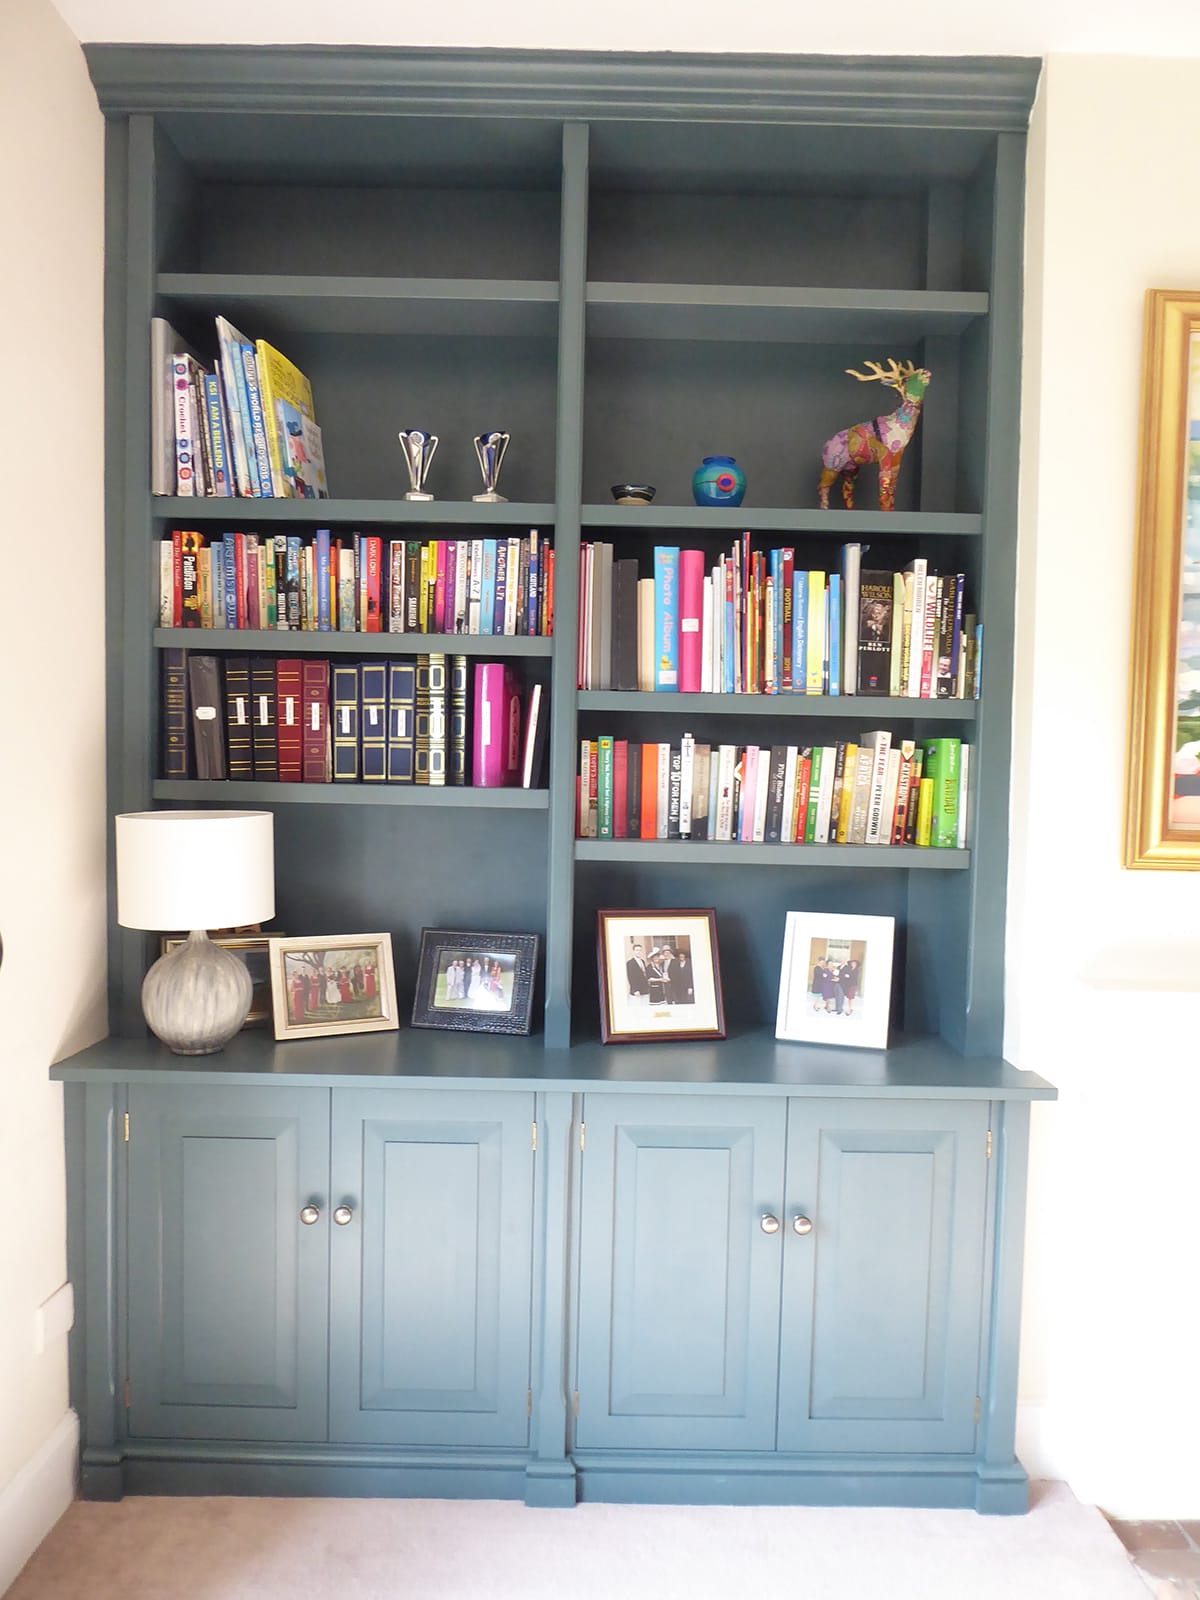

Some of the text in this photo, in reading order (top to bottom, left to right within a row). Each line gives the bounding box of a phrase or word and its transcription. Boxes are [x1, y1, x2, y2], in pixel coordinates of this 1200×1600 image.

[209, 382, 218, 395] KSI
[250, 393, 262, 420] WORLD
[179, 396, 188, 434] Crochet
[211, 406, 219, 420] AM
[214, 430, 223, 467] BELLEND
[184, 556, 196, 590] Patterson
[663, 568, 674, 653] Photo Album
[671, 755, 682, 816] TOP 10 FOR MEN
[871, 743, 888, 836] THE FEAR PETER GODWIN
